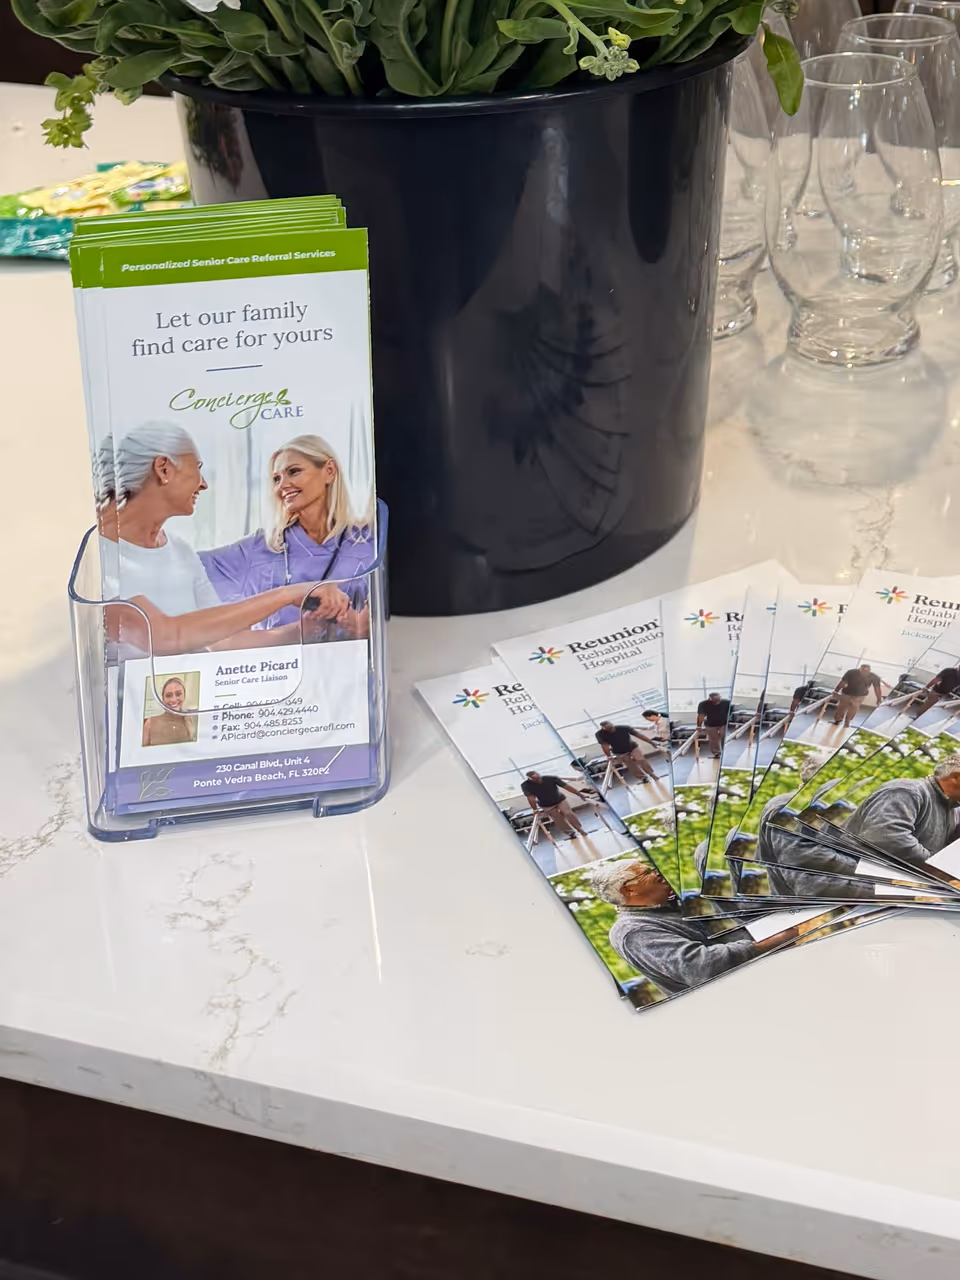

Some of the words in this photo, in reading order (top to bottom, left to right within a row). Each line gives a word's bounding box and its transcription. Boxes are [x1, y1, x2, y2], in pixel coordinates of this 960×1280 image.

[121, 259, 190, 272] Personalized
[191, 257, 225, 268] Senior
[226, 256, 250, 265] Care
[251, 251, 292, 263] Referral
[293, 249, 336, 260] Services
[156, 311, 191, 329] Let
[198, 308, 236, 326] our
[241, 301, 308, 323] family
[131, 337, 174, 357] find
[181, 336, 229, 352] care
[235, 330, 267, 348] for
[273, 327, 333, 350] yours
[168, 387, 282, 429] Concierge
[260, 405, 304, 420] CARE
[566, 619, 661, 654] Reunion
[576, 630, 664, 664] Rehabilitatio
[215, 662, 257, 676] Anette
[260, 658, 299, 672] Picard
[582, 647, 643, 670] Hospital
[214, 677, 240, 687] Senior
[241, 676, 260, 685] Care
[261, 673, 288, 683] Liaison
[221, 711, 254, 721] Phone:
[221, 724, 241, 732] Fax:
[215, 764, 232, 773] 230
[233, 762, 258, 771] Canal
[284, 756, 302, 766] Unit
[303, 756, 310, 764] 4
[193, 778, 223, 788] Ponte
[224, 775, 252, 784] Vedra
[255, 771, 287, 782] Beach,
[288, 769, 301, 779] FL
